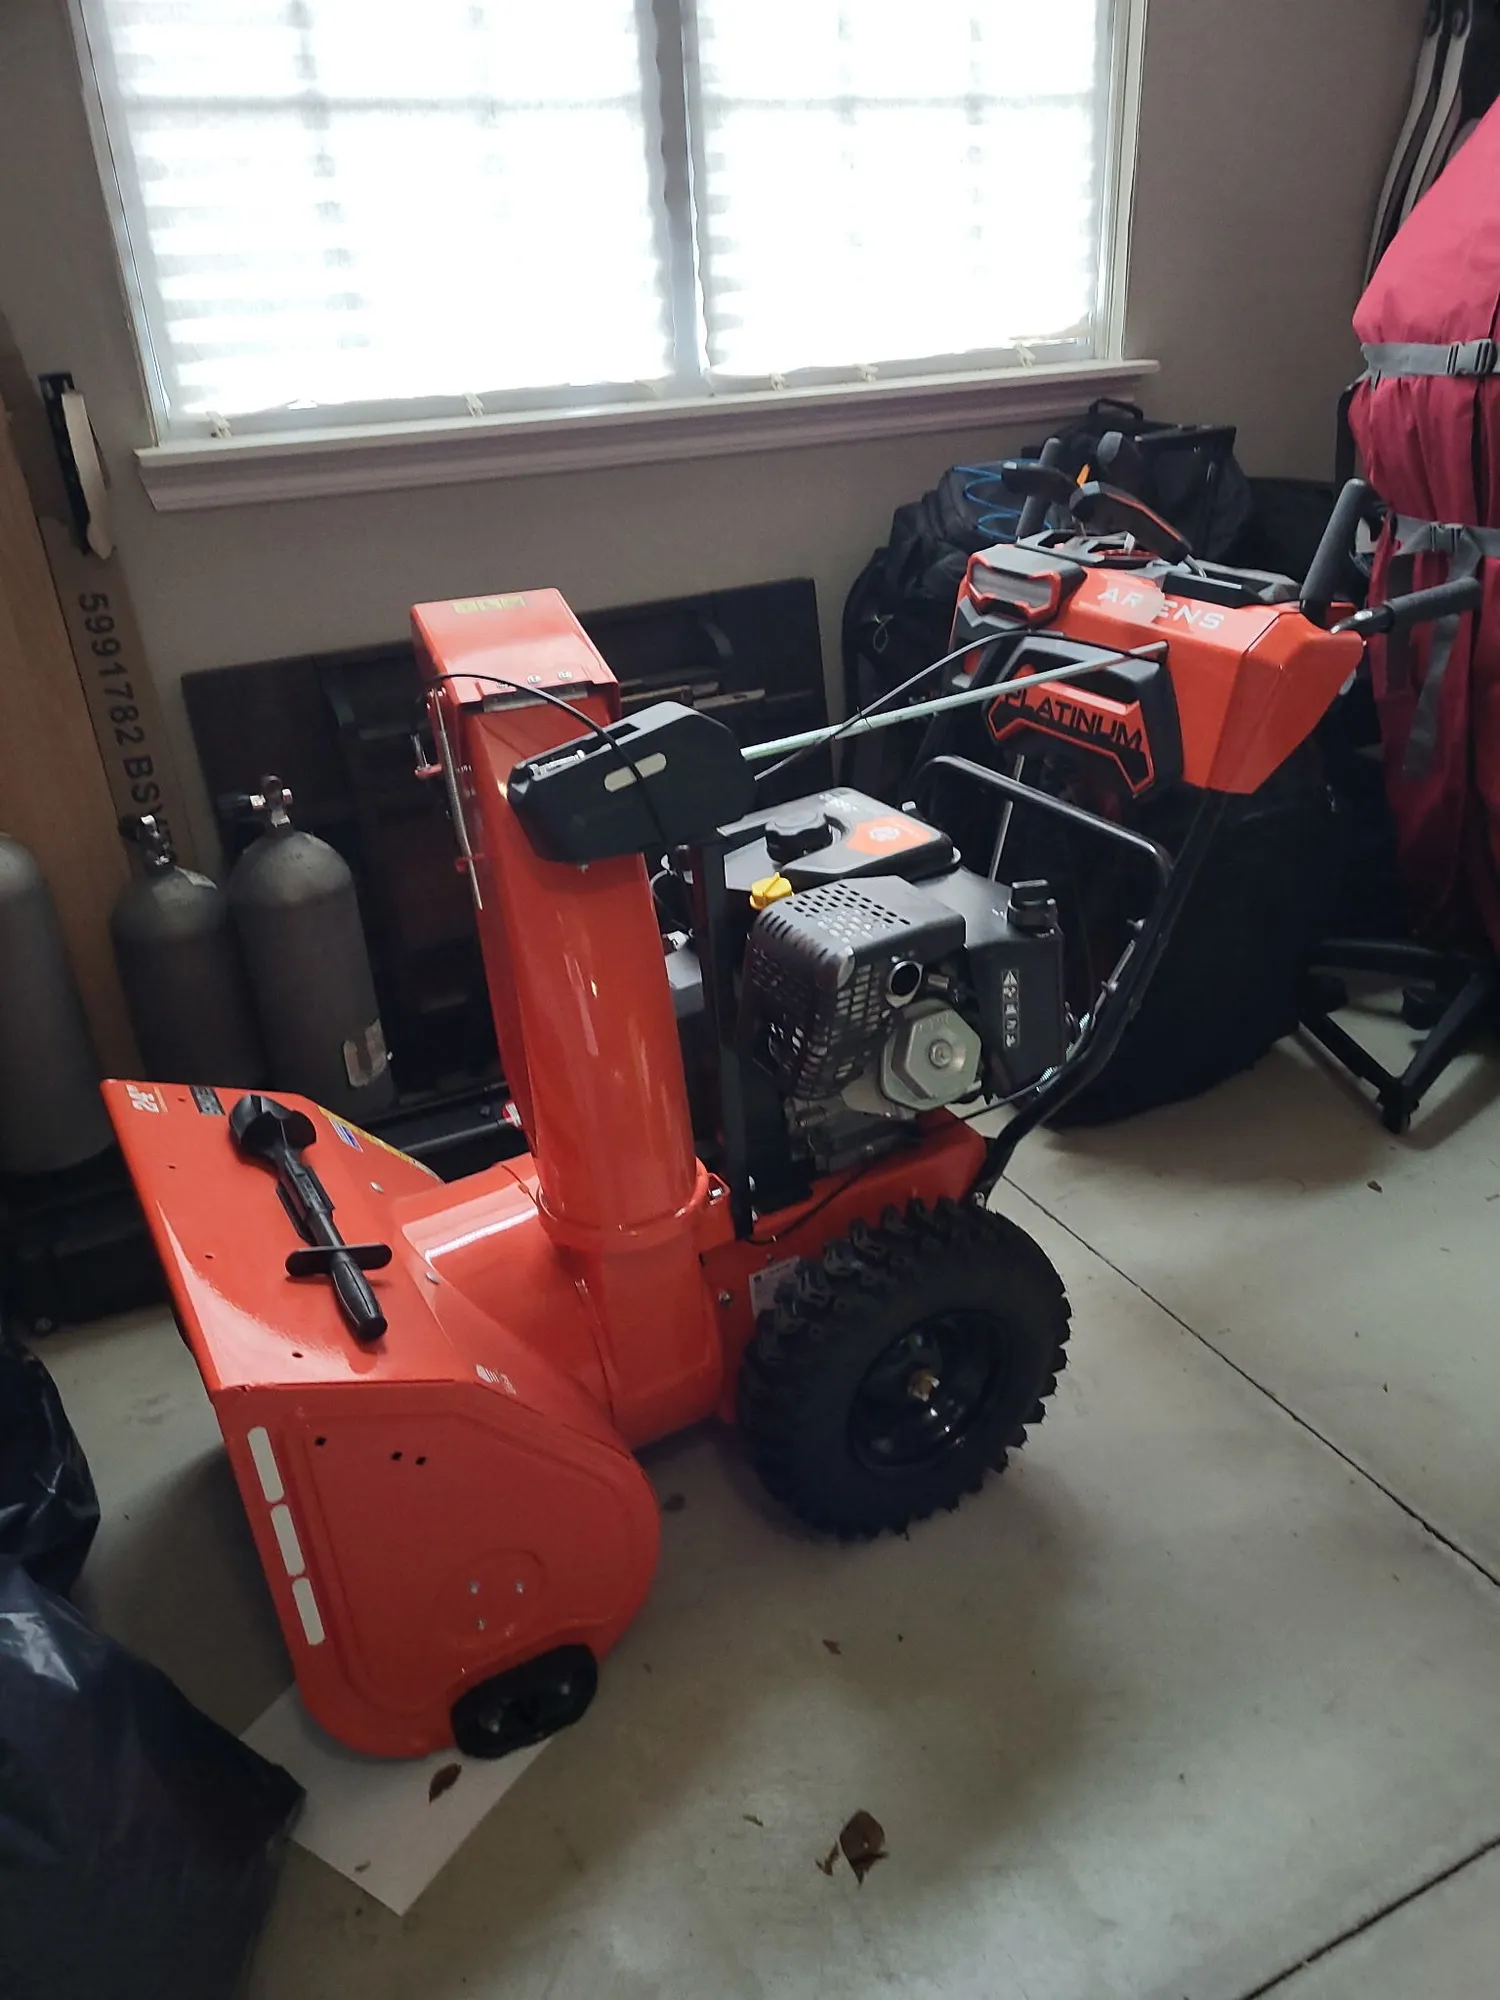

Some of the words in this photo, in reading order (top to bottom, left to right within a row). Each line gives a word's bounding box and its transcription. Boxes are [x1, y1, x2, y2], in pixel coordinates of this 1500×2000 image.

[1097, 587, 1225, 630] ARENS
[79, 592, 145, 746] 5991782
[1005, 688, 1143, 751] PLATINUM
